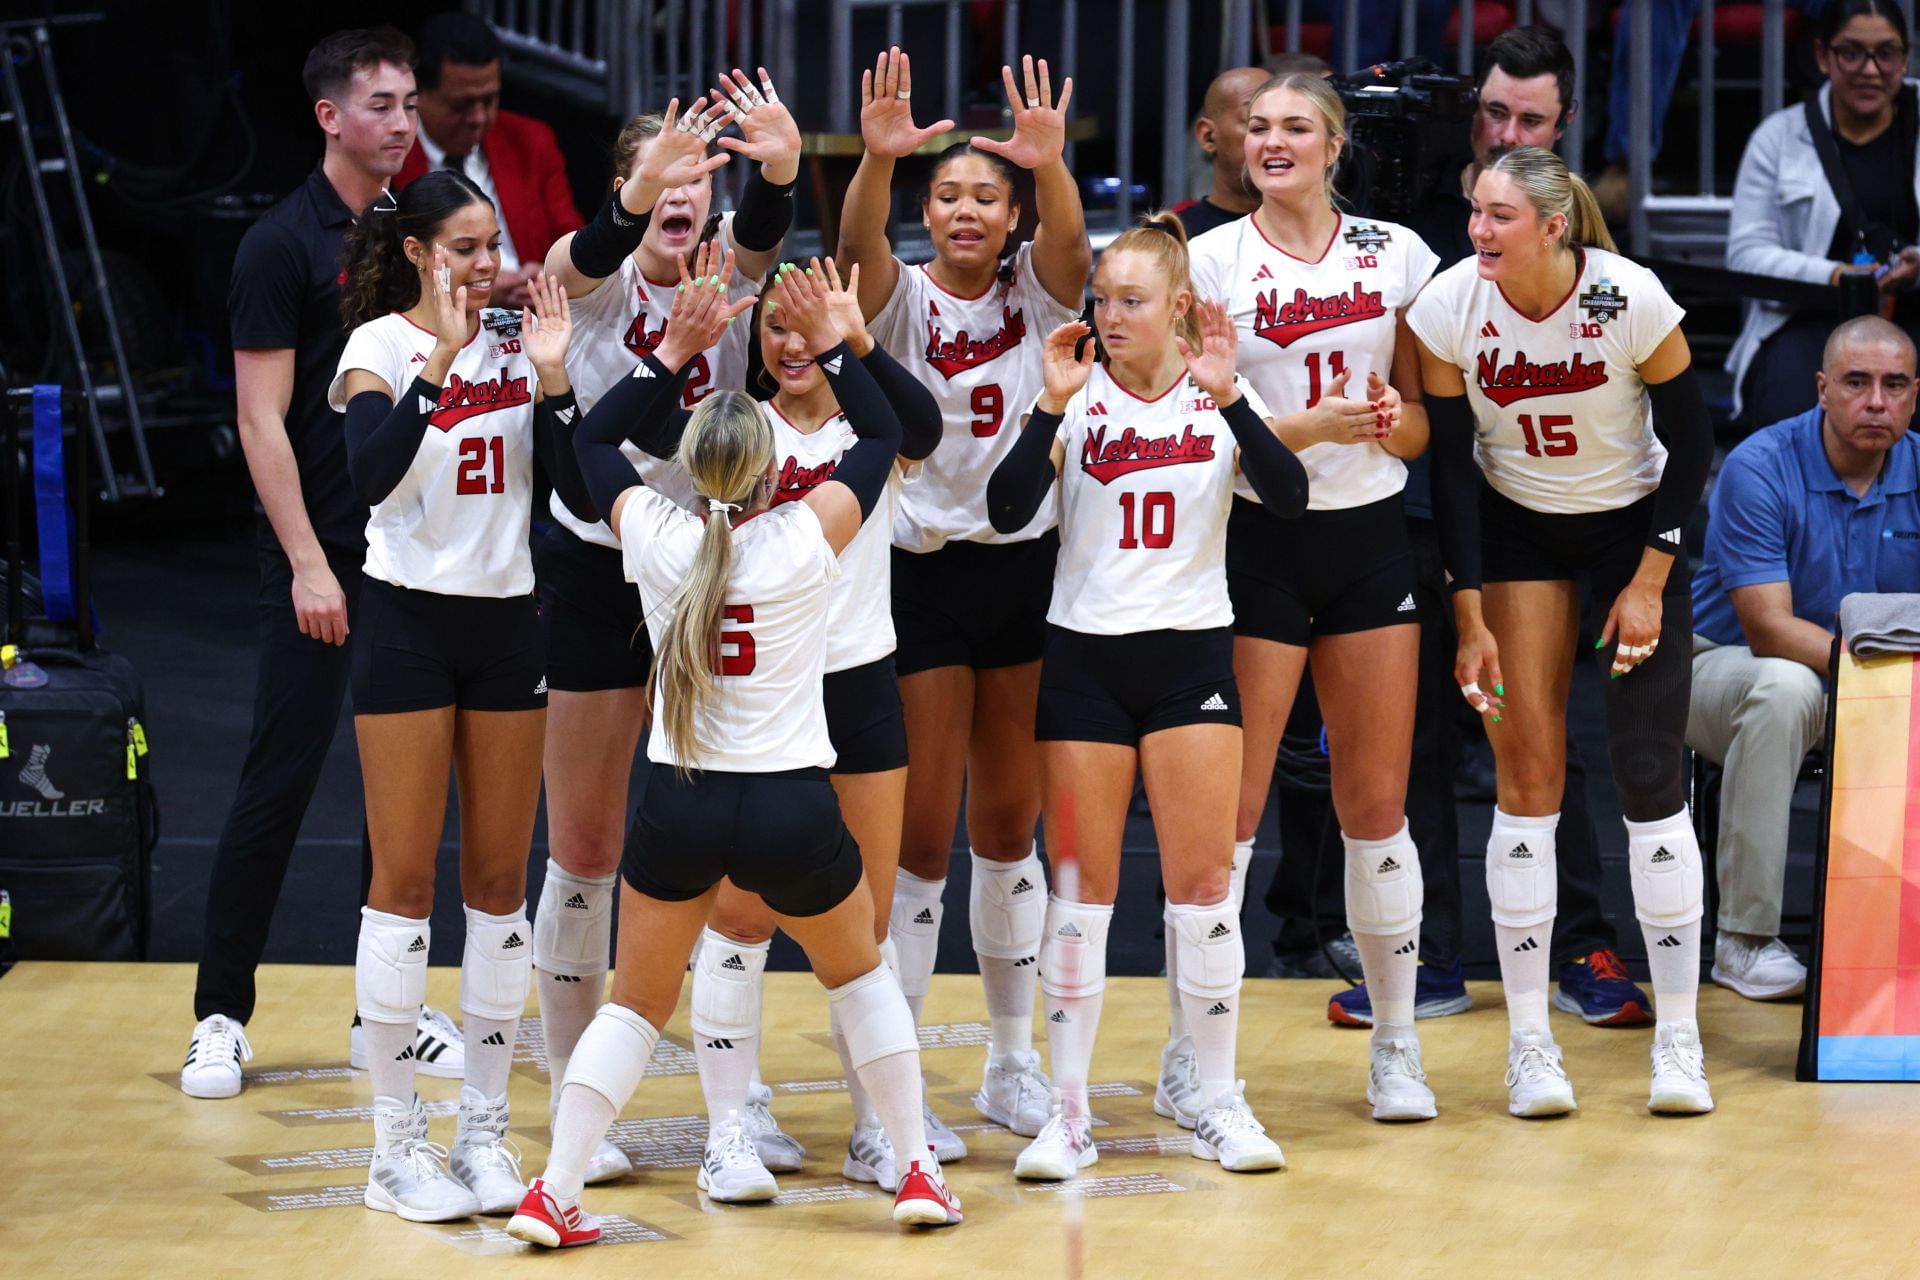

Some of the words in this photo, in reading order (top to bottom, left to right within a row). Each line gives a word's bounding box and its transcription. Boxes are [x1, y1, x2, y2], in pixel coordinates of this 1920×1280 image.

[1253, 282, 1387, 331] Nebraska
[1583, 299, 1625, 307] CHAMPIONSHIP
[1477, 347, 1608, 387] Nebraska
[437, 367, 531, 409] ebraska
[971, 383, 1004, 438] 9
[1517, 414, 1578, 457] 15
[1081, 424, 1215, 465] Nebraska
[457, 436, 504, 495] 21
[1119, 491, 1175, 549] 10
[1509, 851, 1533, 859] adidas
[1651, 854, 1675, 863] adidas
[1377, 864, 1400, 874] adidas
[1011, 884, 1034, 895] adidas
[564, 901, 588, 909] adidas
[408, 945, 427, 953] adidas
[502, 940, 524, 950] adidas
[722, 962, 745, 971] adidas
